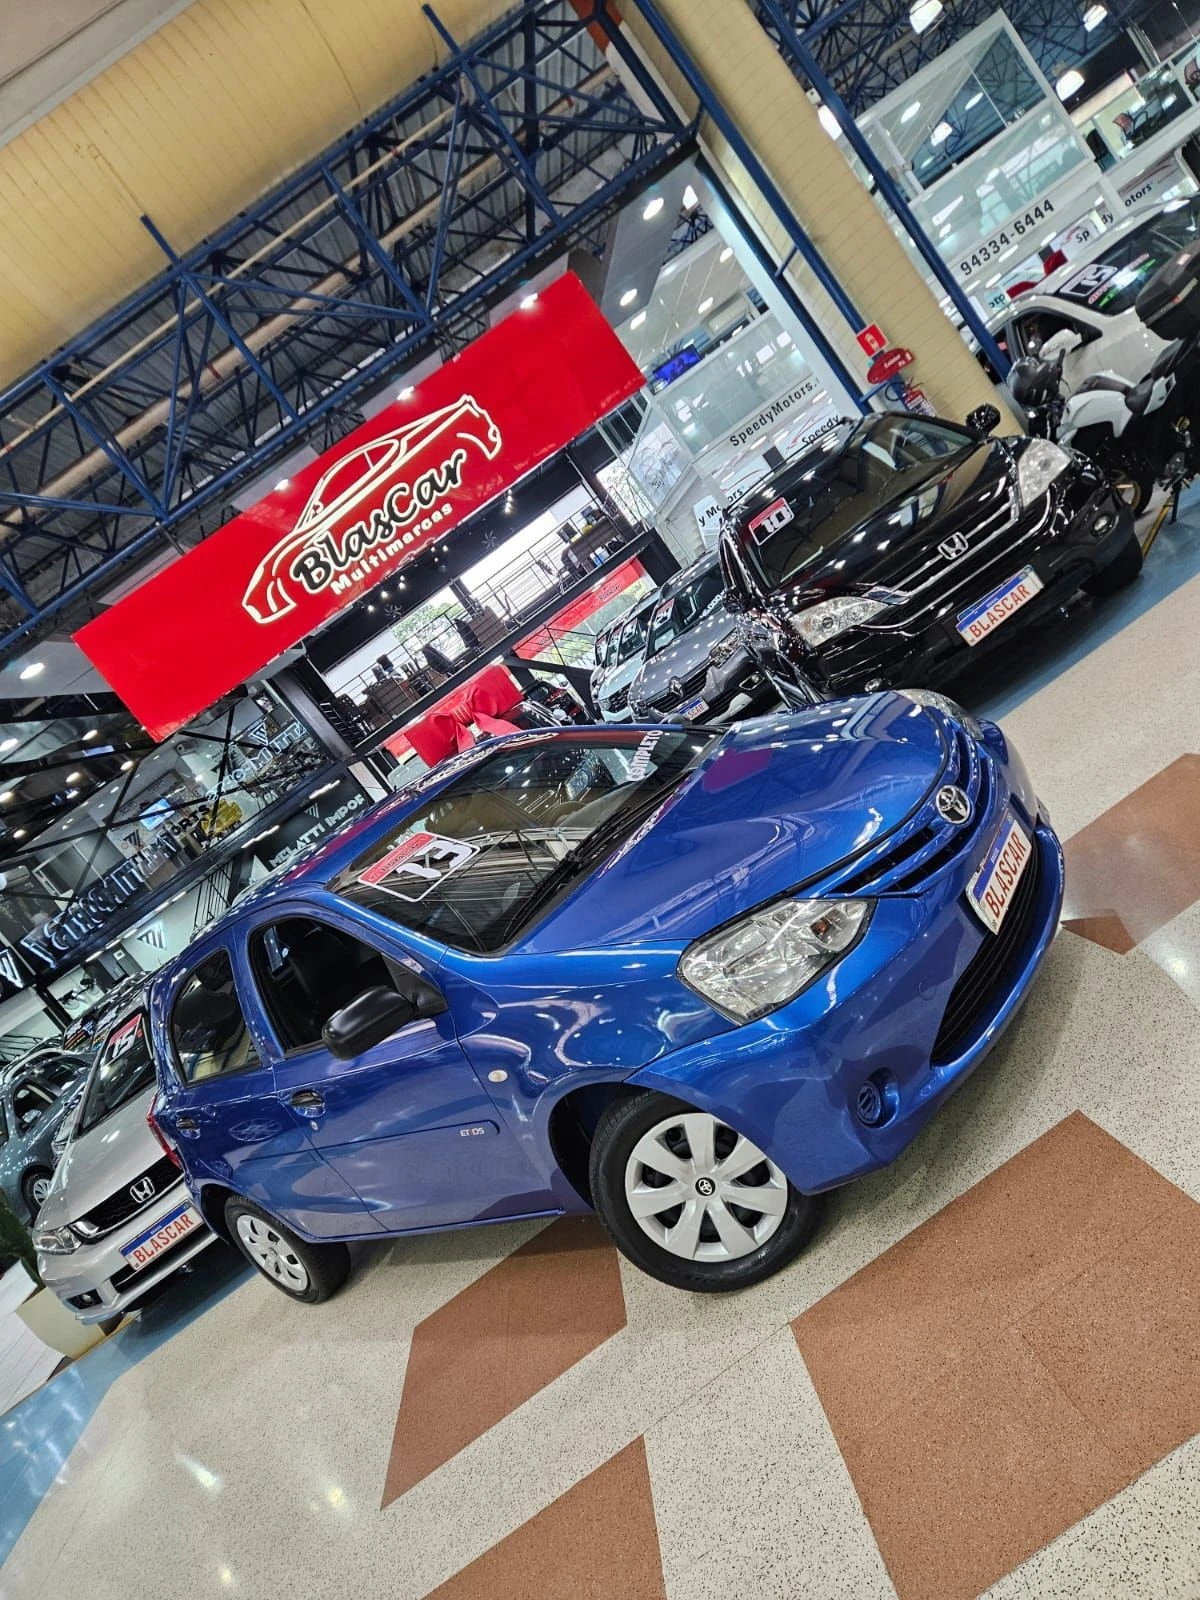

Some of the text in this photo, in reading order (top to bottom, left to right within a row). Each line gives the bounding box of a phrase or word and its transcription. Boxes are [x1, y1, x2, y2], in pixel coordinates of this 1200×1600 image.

[960, 199, 1055, 276] 94334-6444
[730, 378, 820, 447] SpeedyMotors.
[290, 450, 466, 592] BlasCar
[330, 502, 454, 596] Multimarcas
[761, 506, 793, 533] 10
[969, 584, 1031, 638] BLASCAR
[985, 831, 1027, 919] BLASCAR
[132, 1213, 195, 1263] BLASCAR
